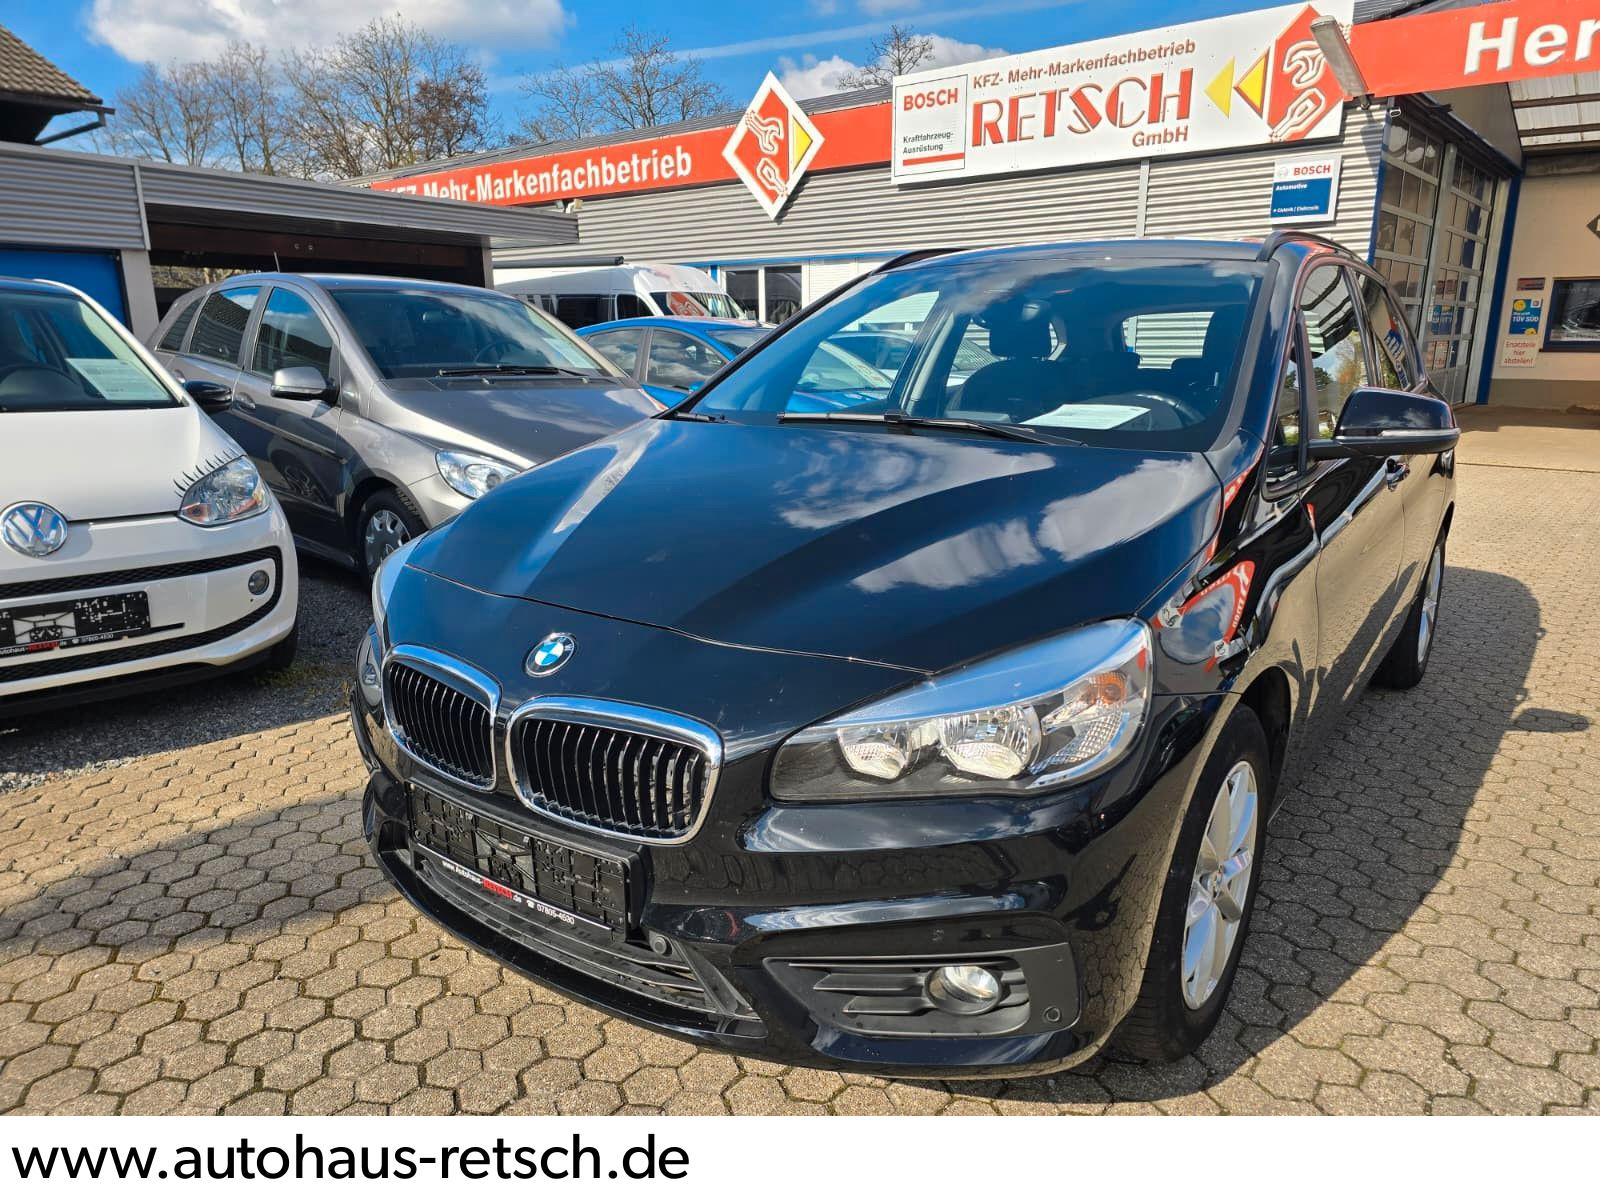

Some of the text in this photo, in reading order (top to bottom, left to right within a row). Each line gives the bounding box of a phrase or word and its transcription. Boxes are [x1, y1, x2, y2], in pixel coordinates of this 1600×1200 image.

[973, 38, 1197, 89] KFZ- Mehr-Markenfachbetrieb
[903, 87, 959, 111] BOSCH
[972, 67, 1194, 148] RETSCH
[902, 131, 955, 144] Kraftfahrzeug-
[1132, 125, 1189, 148] GmbH
[902, 143, 945, 155] Ausrüstung
[423, 144, 693, 203] Mehr-Markenfachbetrieb
[1293, 164, 1332, 177] BOSCH
